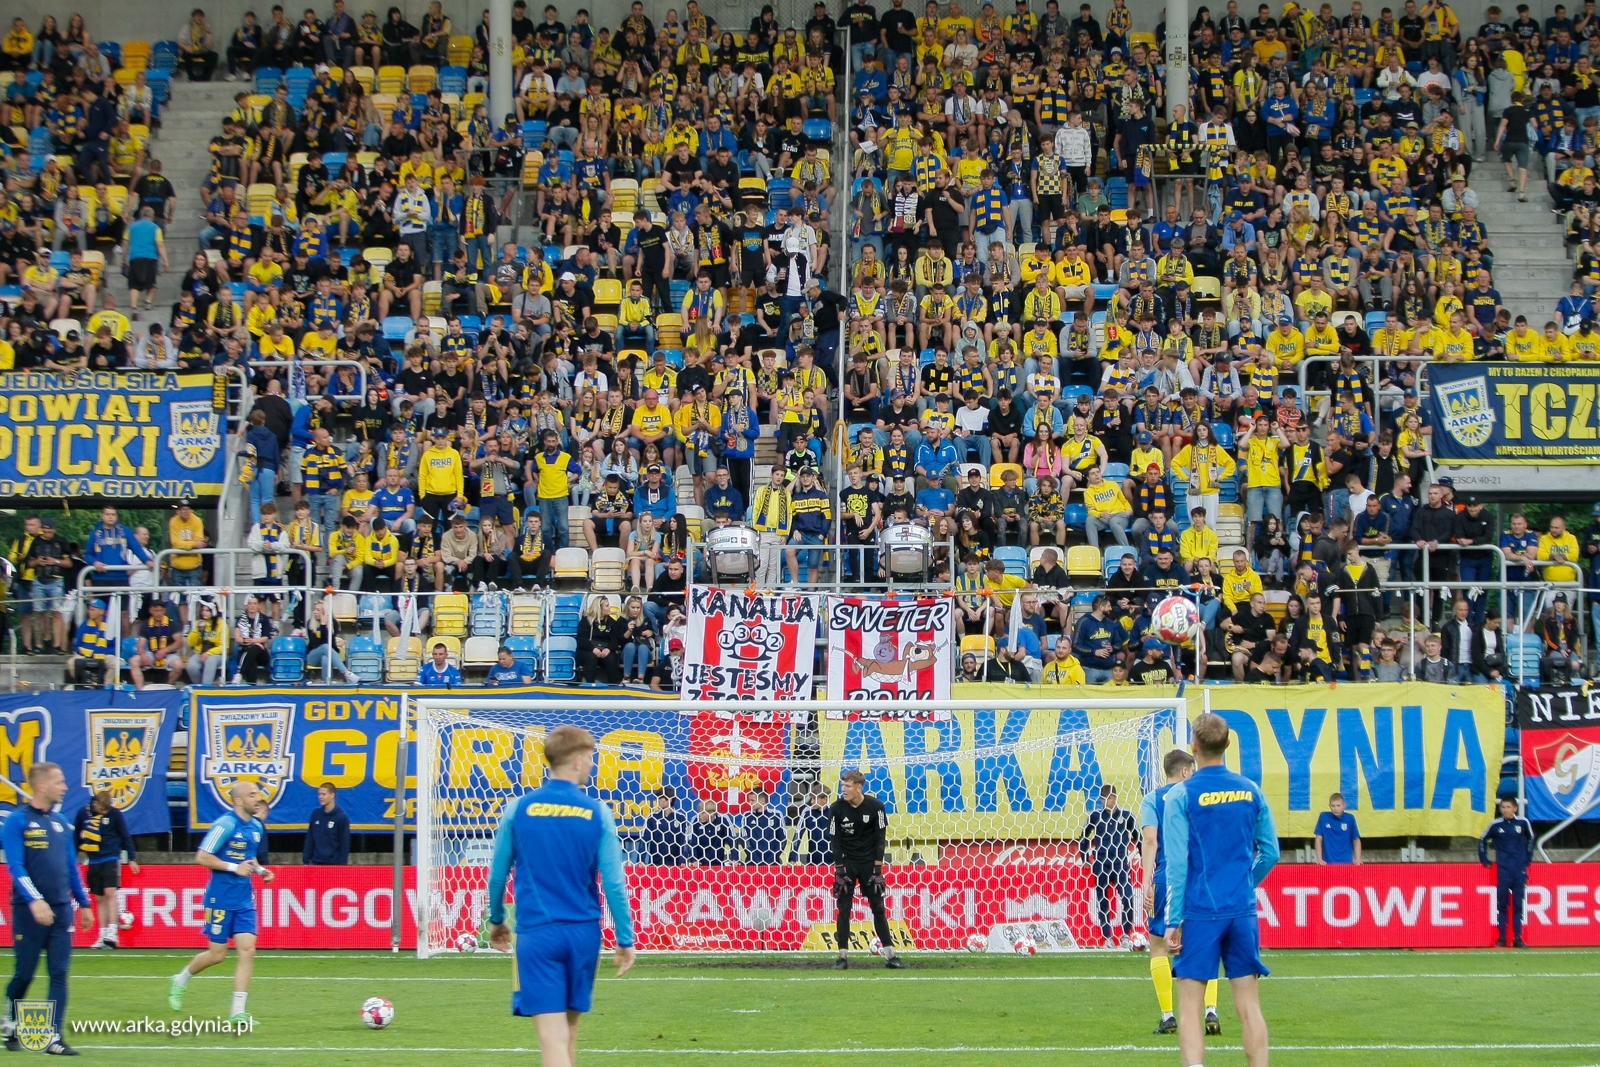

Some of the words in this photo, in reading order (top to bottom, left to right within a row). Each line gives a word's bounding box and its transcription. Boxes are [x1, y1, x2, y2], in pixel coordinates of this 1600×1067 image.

[126, 371, 182, 390] SIŁA
[1515, 367, 1542, 377] RAZEM
[0, 393, 161, 422] OWIAT
[1495, 382, 1600, 441] TCZ
[1451, 413, 1488, 428] ARKA
[176, 437, 213, 446] ARKA
[430, 458, 452, 467] ARKA
[20, 478, 95, 496] ARKA
[102, 479, 198, 499] GDYNIA
[1094, 489, 1116, 503] ARKA
[691, 587, 815, 623] KANALIA
[830, 602, 950, 634] SWETER
[685, 663, 809, 693] JESTEŚMY
[97, 763, 141, 779] ARKA
[217, 762, 278, 775] ARKA
[838, 708, 1104, 814] ARKA
[1198, 790, 1253, 807] GDYNIA
[526, 802, 594, 821] GDYNIA
[117, 887, 493, 928] TREINGOW
[600, 887, 977, 928] KAWOSTKI
[821, 930, 914, 951] FRTNA
